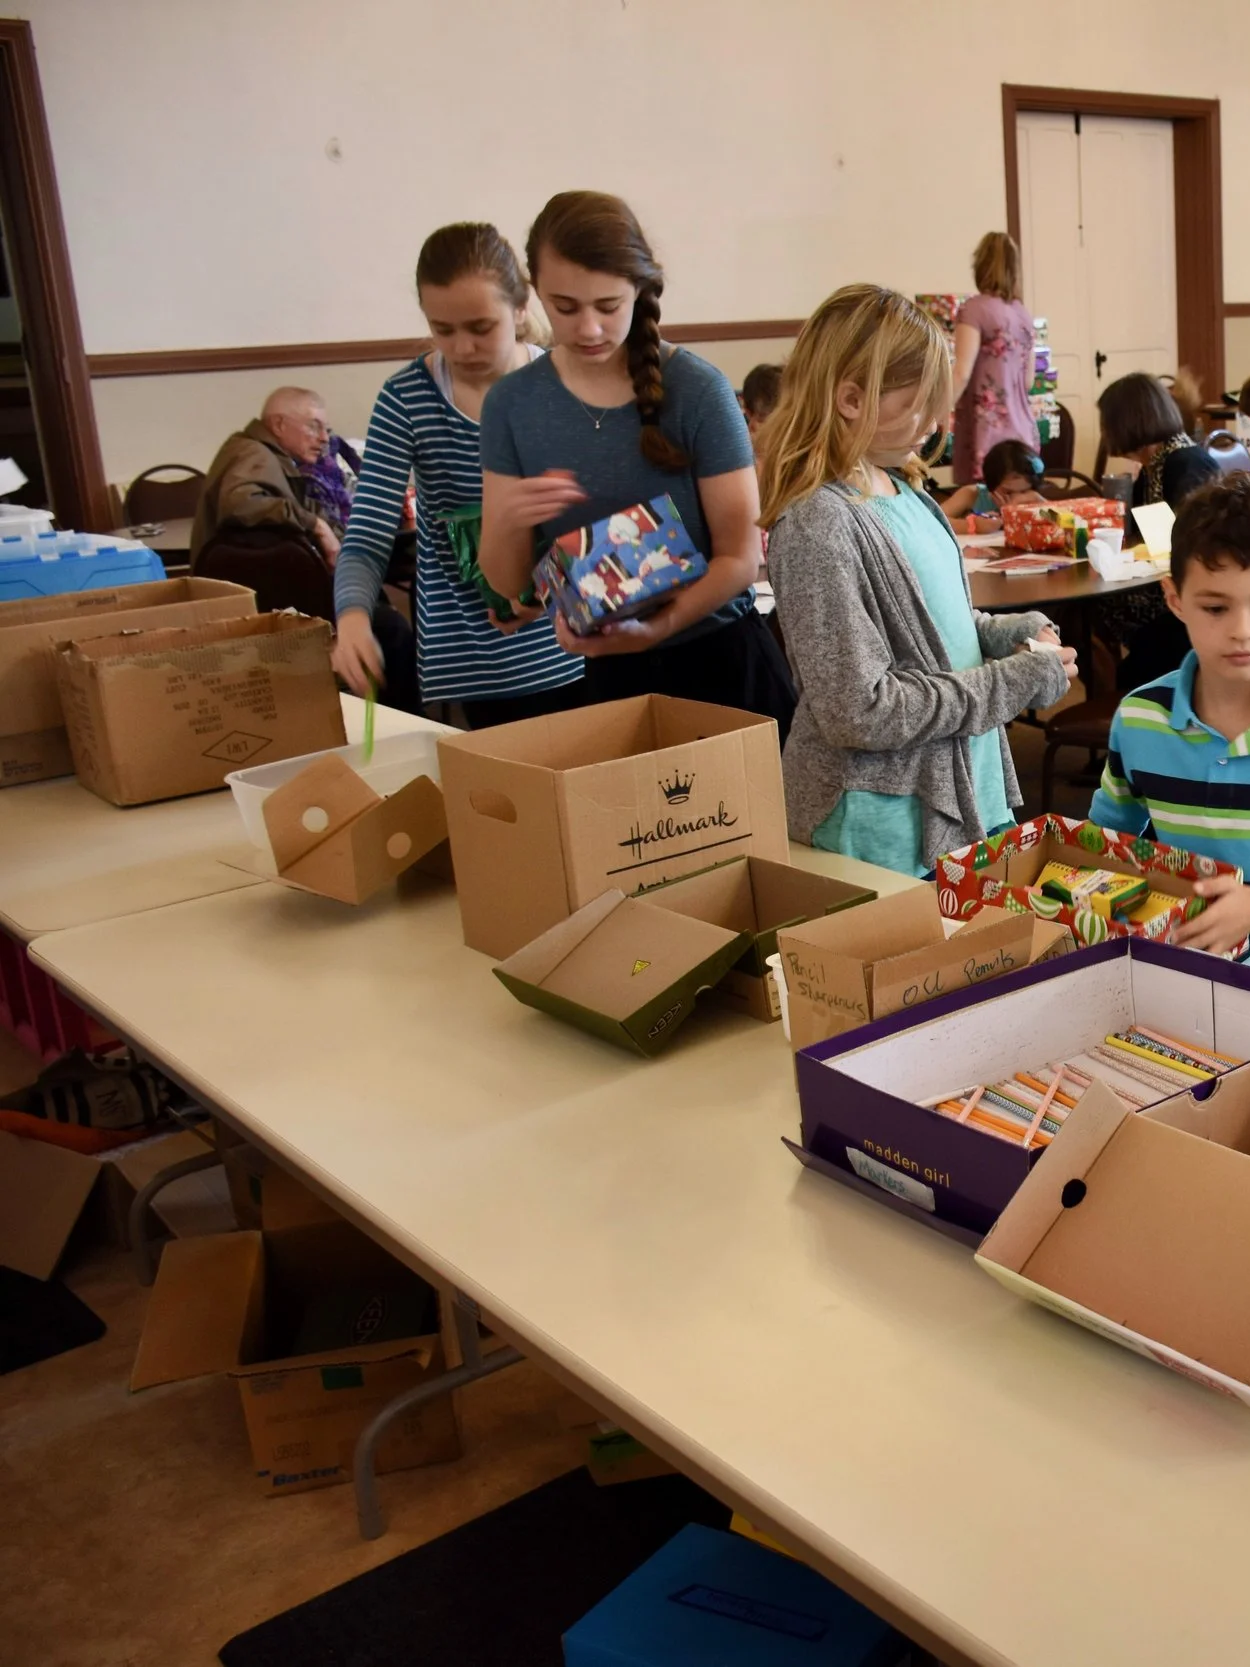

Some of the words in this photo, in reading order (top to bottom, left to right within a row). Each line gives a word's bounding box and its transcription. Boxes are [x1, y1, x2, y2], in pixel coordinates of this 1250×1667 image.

[618, 801, 739, 859] Hallmark
[786, 952, 826, 984] Pencil
[647, 1000, 683, 1039] KEEN
[859, 1160, 908, 1194] Markers
[863, 1138, 919, 1174] madden
[924, 1167, 951, 1188] girl
[355, 1296, 384, 1344] KEEN
[273, 1465, 340, 1487] Baxter
